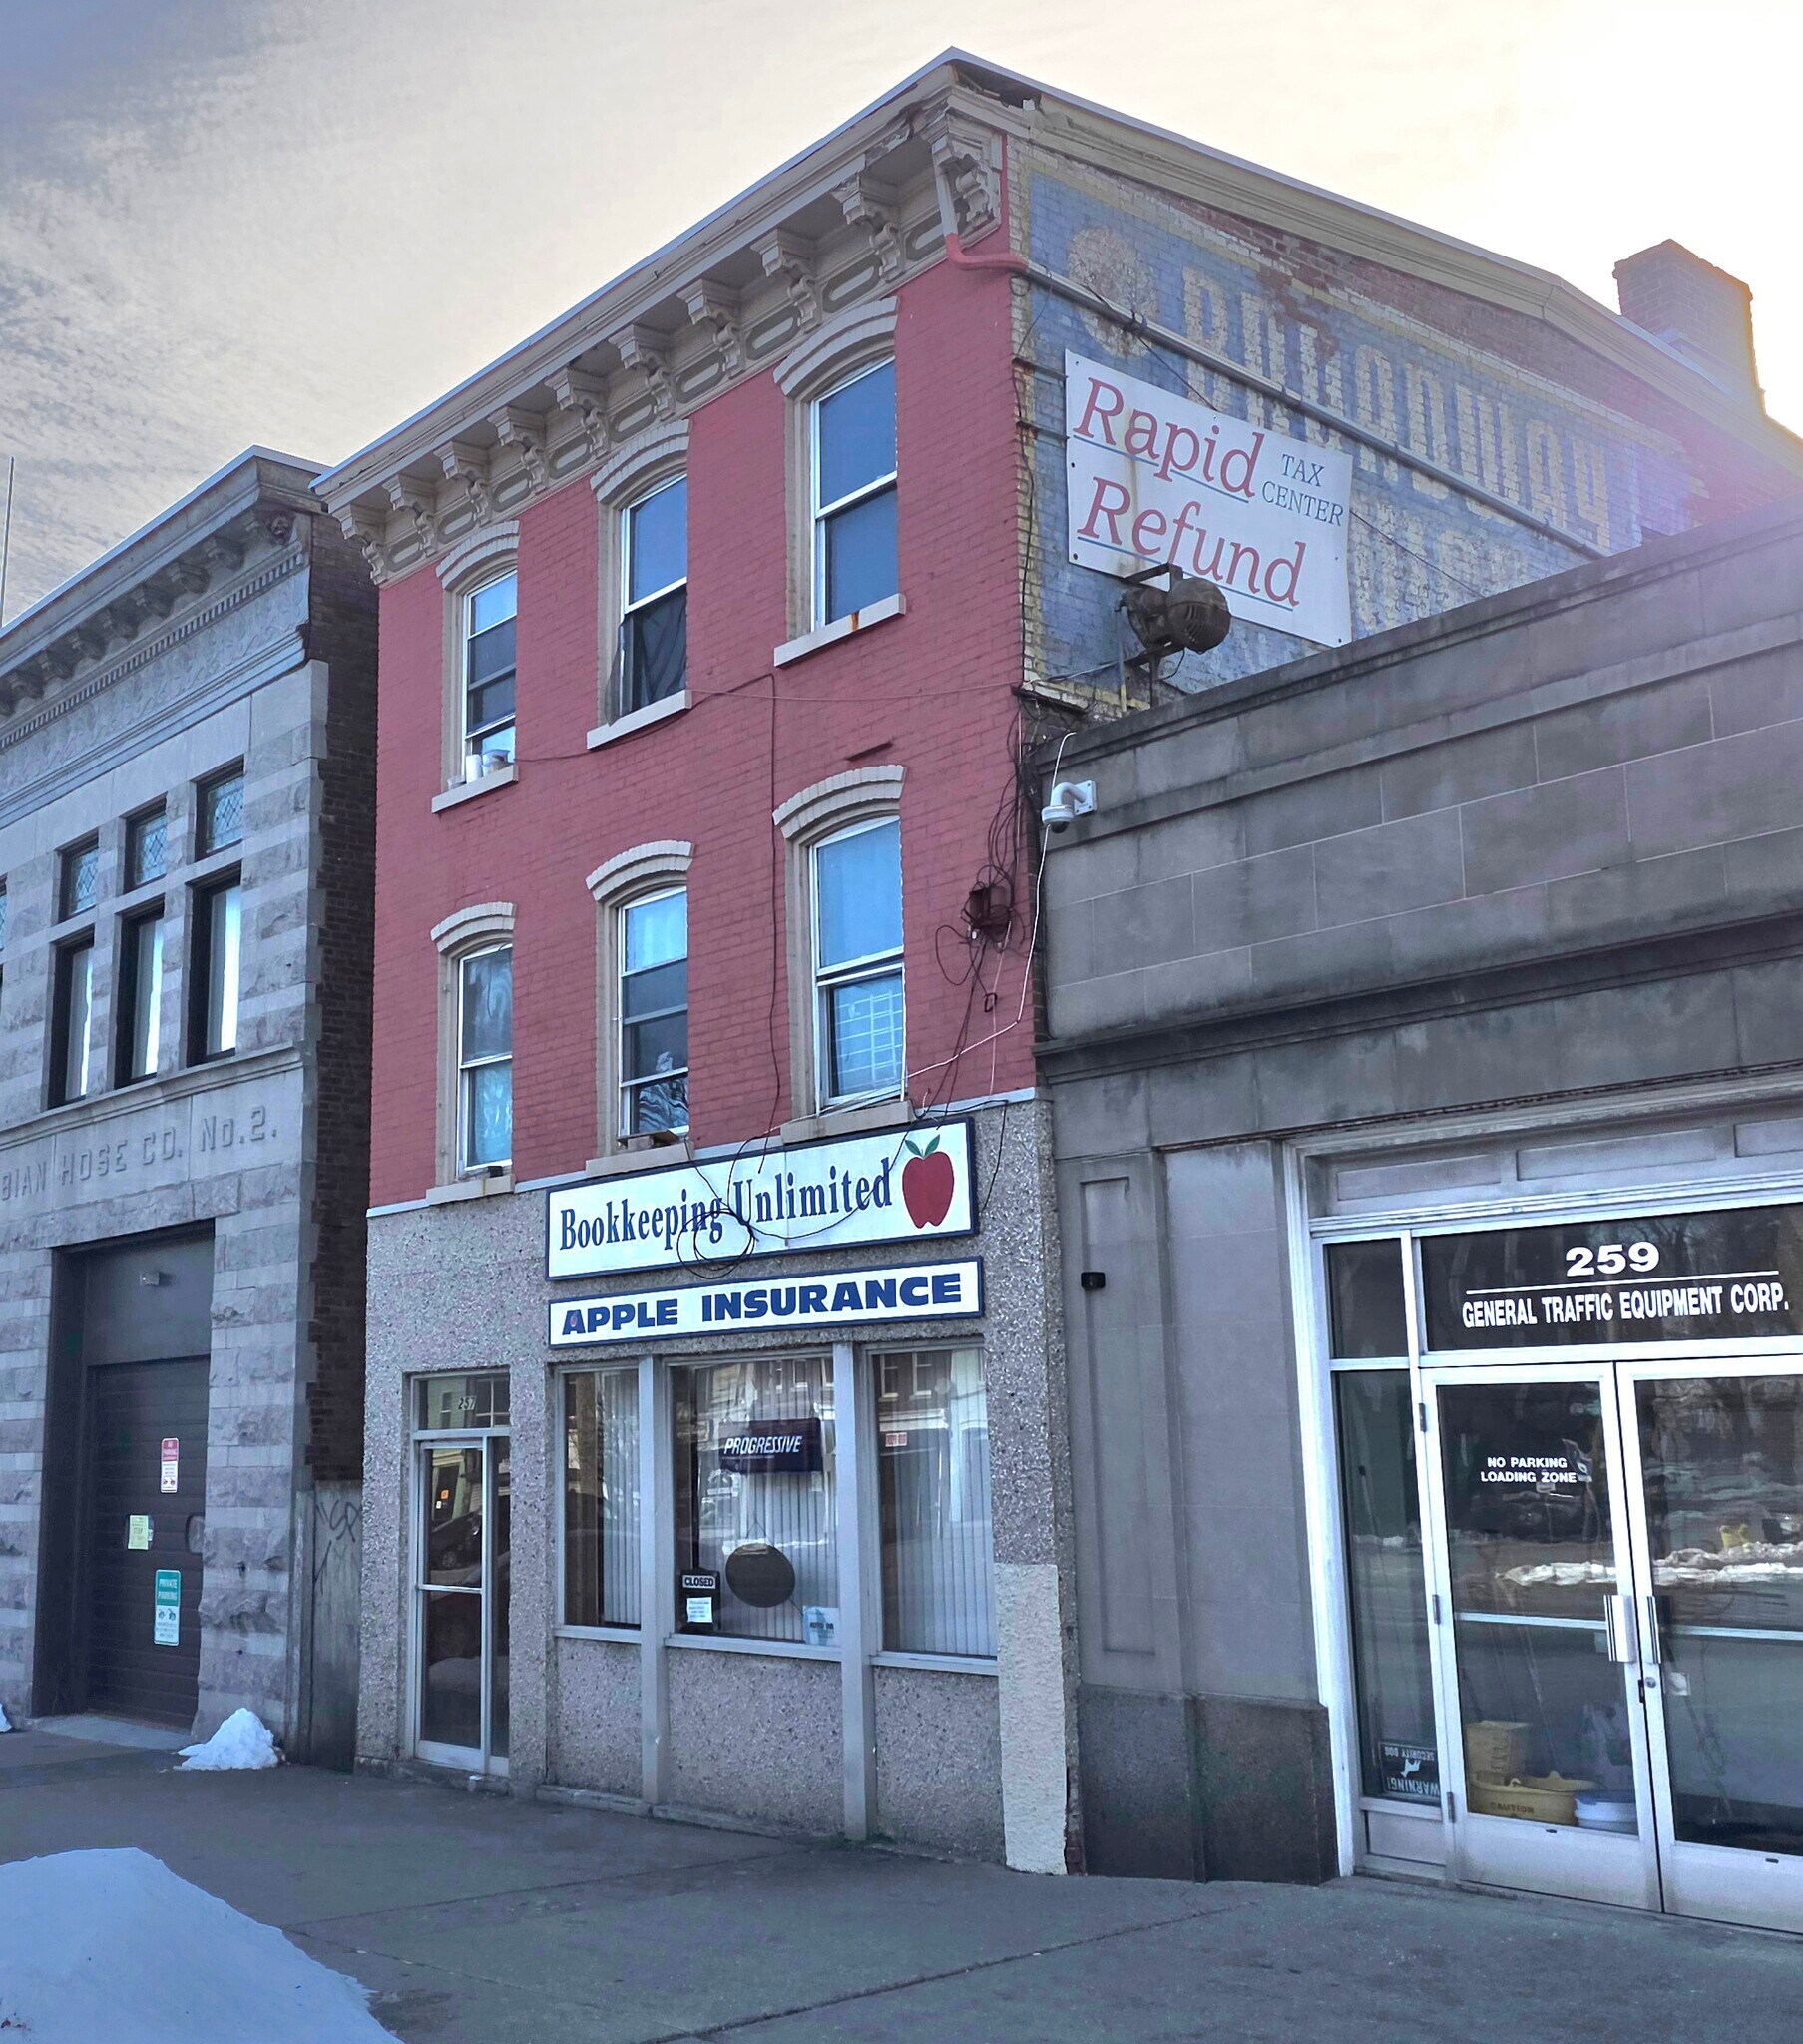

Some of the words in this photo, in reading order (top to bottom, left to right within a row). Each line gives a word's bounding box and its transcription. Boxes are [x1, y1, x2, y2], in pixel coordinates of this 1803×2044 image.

[1073, 377, 1264, 497] Rapid
[1280, 453, 1325, 487] TAX
[1262, 480, 1344, 527] CENTER
[1078, 476, 1306, 607] Refund
[61, 1139, 128, 1186] HOSE
[142, 1127, 182, 1165] CO.
[560, 1188, 723, 1251] Bookkeeping
[734, 1157, 892, 1225] Unlimited
[1565, 1241, 1660, 1277] 259
[562, 1298, 678, 1335] APPLE
[701, 1273, 961, 1322] INSURANCE
[1462, 1298, 1538, 1328] GENERAL
[1542, 1293, 1614, 1323] TRAFFIC
[1620, 1286, 1723, 1320] EQUIPMENT
[1730, 1282, 1789, 1313] CORP.
[458, 1396, 477, 1410] 257
[723, 1435, 802, 1455] PROGRESSIVE
[1487, 1458, 1506, 1469] NO
[1511, 1457, 1568, 1469] PARKING
[1481, 1471, 1537, 1483] LOADING
[1541, 1471, 1577, 1484] ZONE
[684, 1577, 714, 1587] CLOSED
